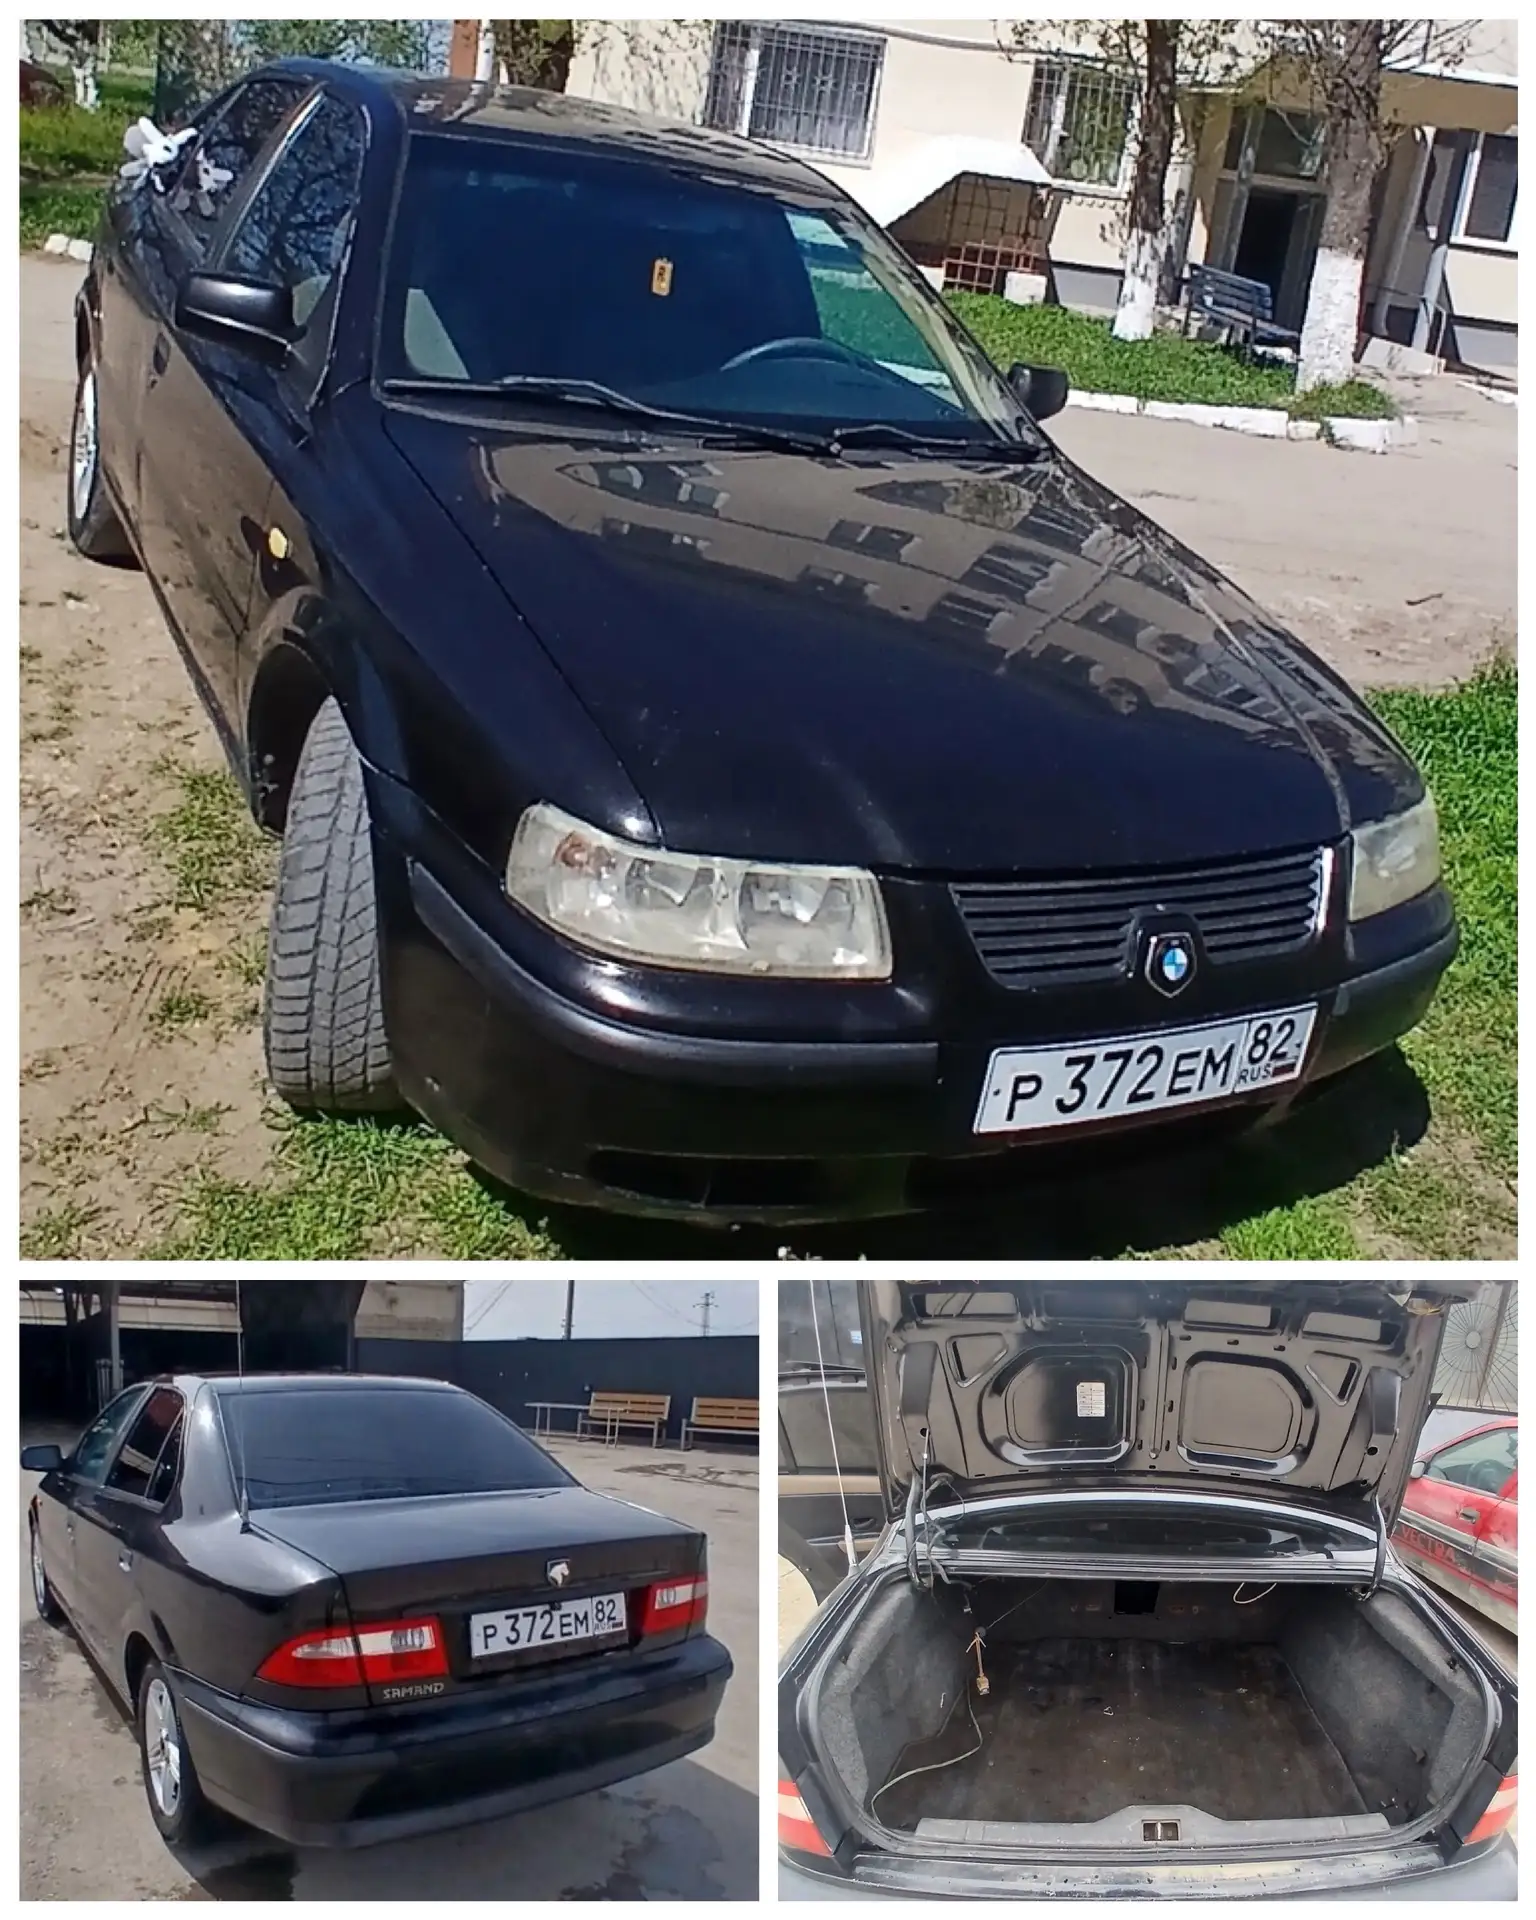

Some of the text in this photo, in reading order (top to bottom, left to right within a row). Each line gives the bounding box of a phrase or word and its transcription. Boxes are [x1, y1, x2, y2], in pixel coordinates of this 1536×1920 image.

[1248, 1018, 1296, 1065] 82
[1238, 1063, 1272, 1085] RUS
[1402, 1524, 1456, 1563] VECTRA
[595, 1599, 617, 1623] 82
[383, 1682, 445, 1700] SAMAND
